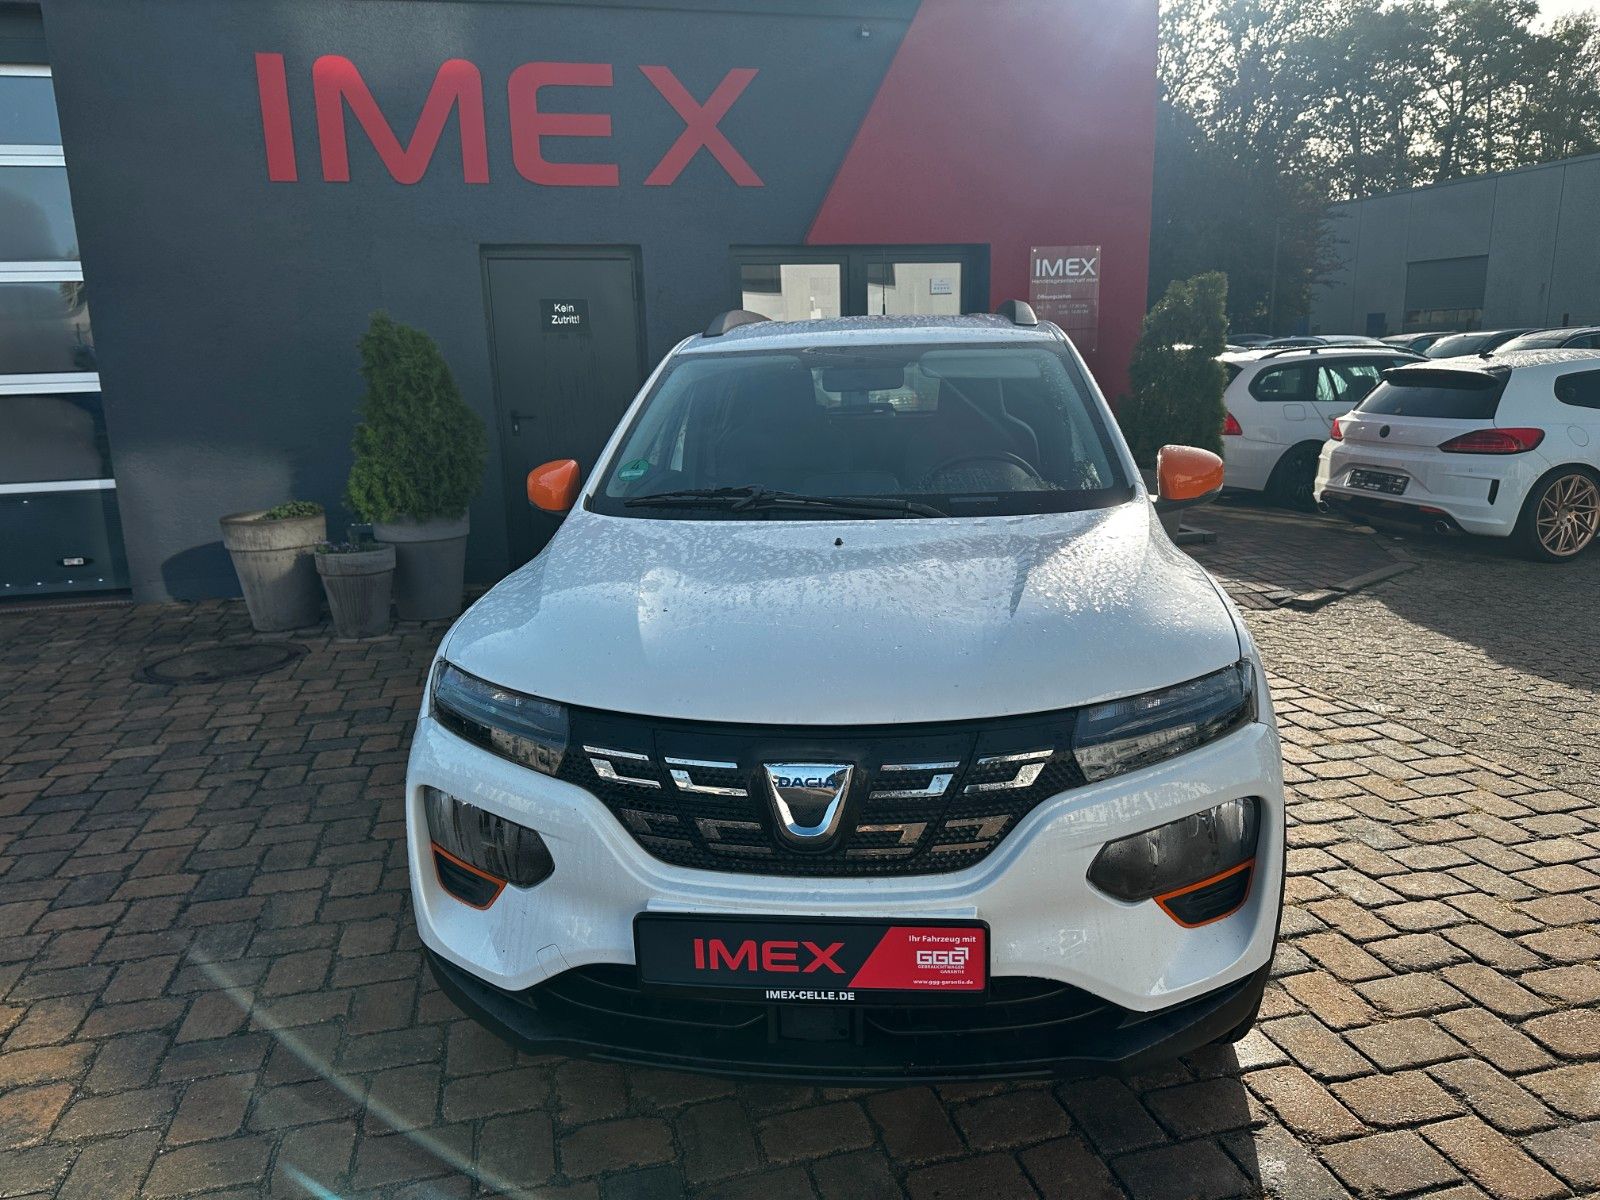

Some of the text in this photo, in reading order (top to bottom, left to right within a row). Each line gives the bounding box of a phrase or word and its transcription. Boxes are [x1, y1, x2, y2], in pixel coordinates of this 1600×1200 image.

[255, 52, 765, 187] IMEX
[1036, 257, 1097, 276] IMEX
[554, 303, 575, 313] Kein
[551, 314, 580, 325] Zutritt!
[778, 776, 836, 788] DACIA
[922, 935, 960, 944] Fahrzeug
[694, 938, 847, 974] IMEX
[916, 950, 965, 965] GGG
[765, 990, 855, 1001] IMEX-CELLE.DE
